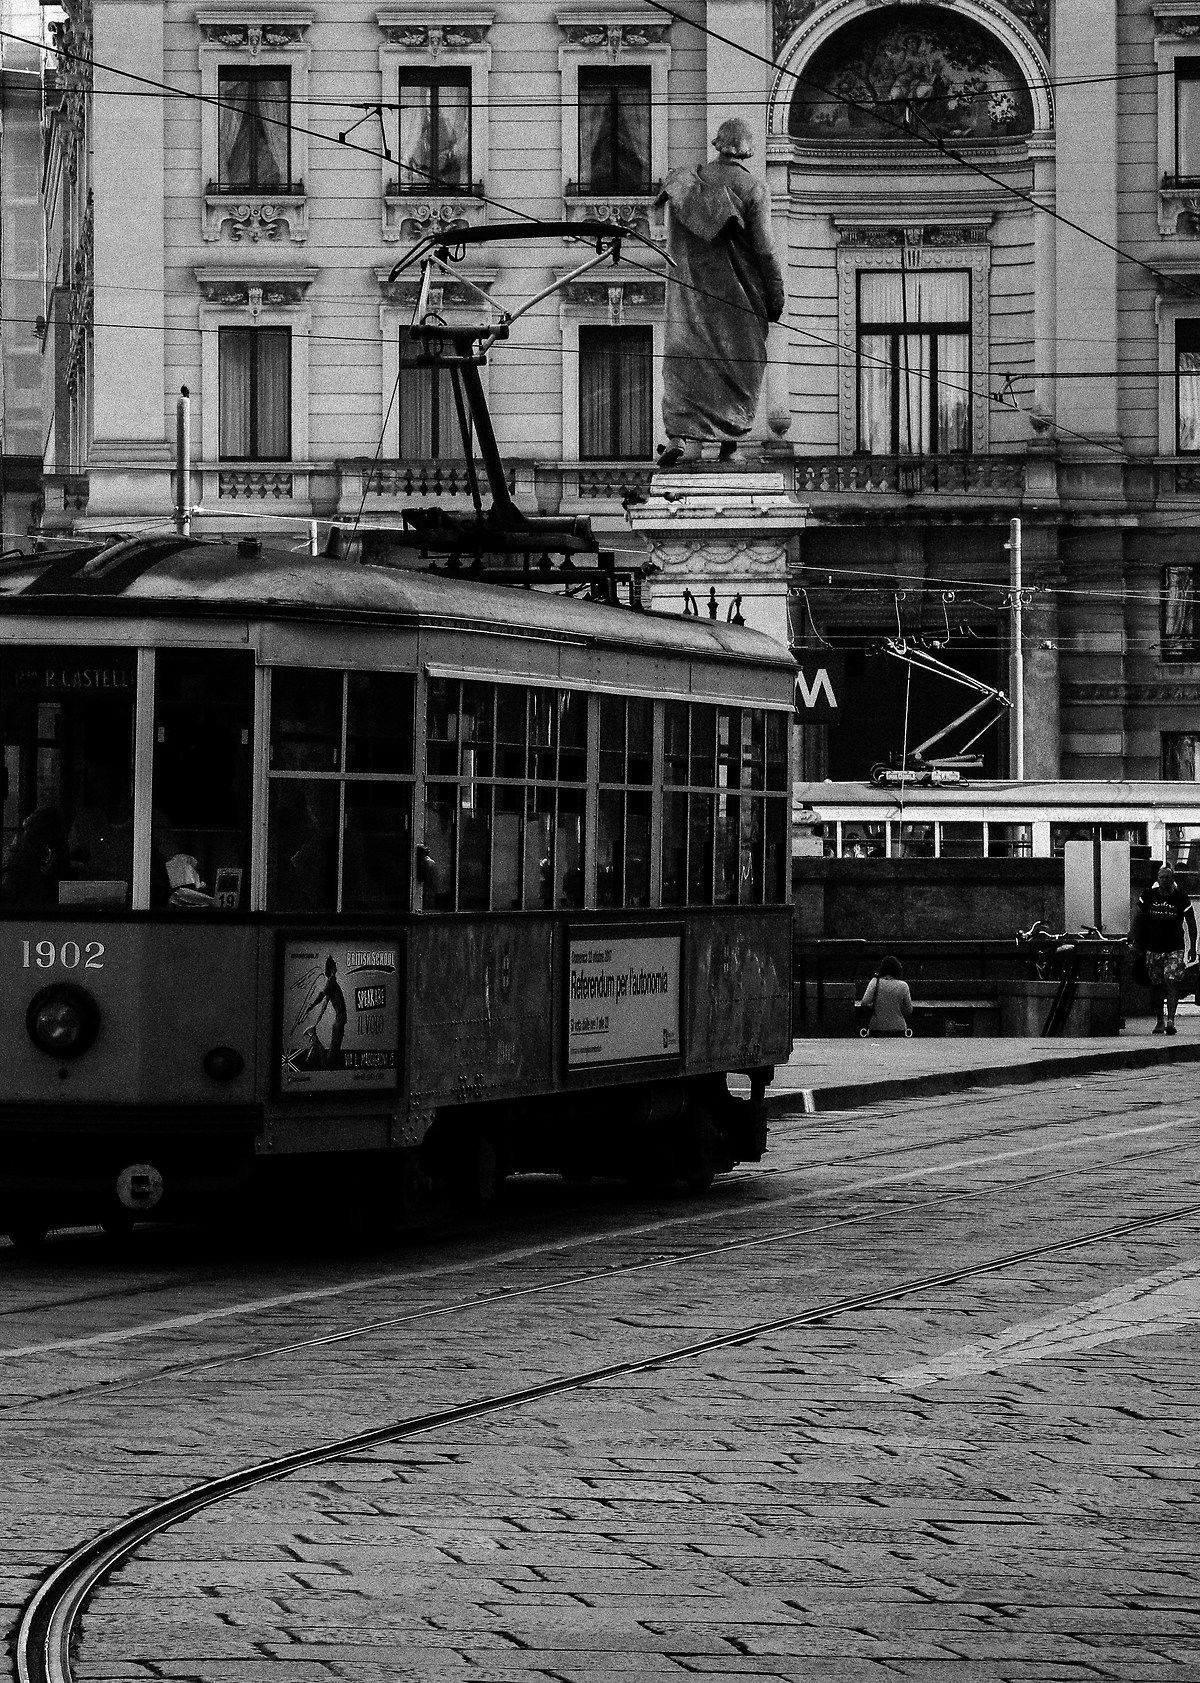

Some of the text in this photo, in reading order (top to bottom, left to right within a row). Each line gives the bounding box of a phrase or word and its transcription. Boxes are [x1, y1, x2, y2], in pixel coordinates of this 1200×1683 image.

[794, 668, 838, 708] M
[22, 940, 105, 969] 1902
[570, 965, 668, 1004] Referendum per l'autonomia
